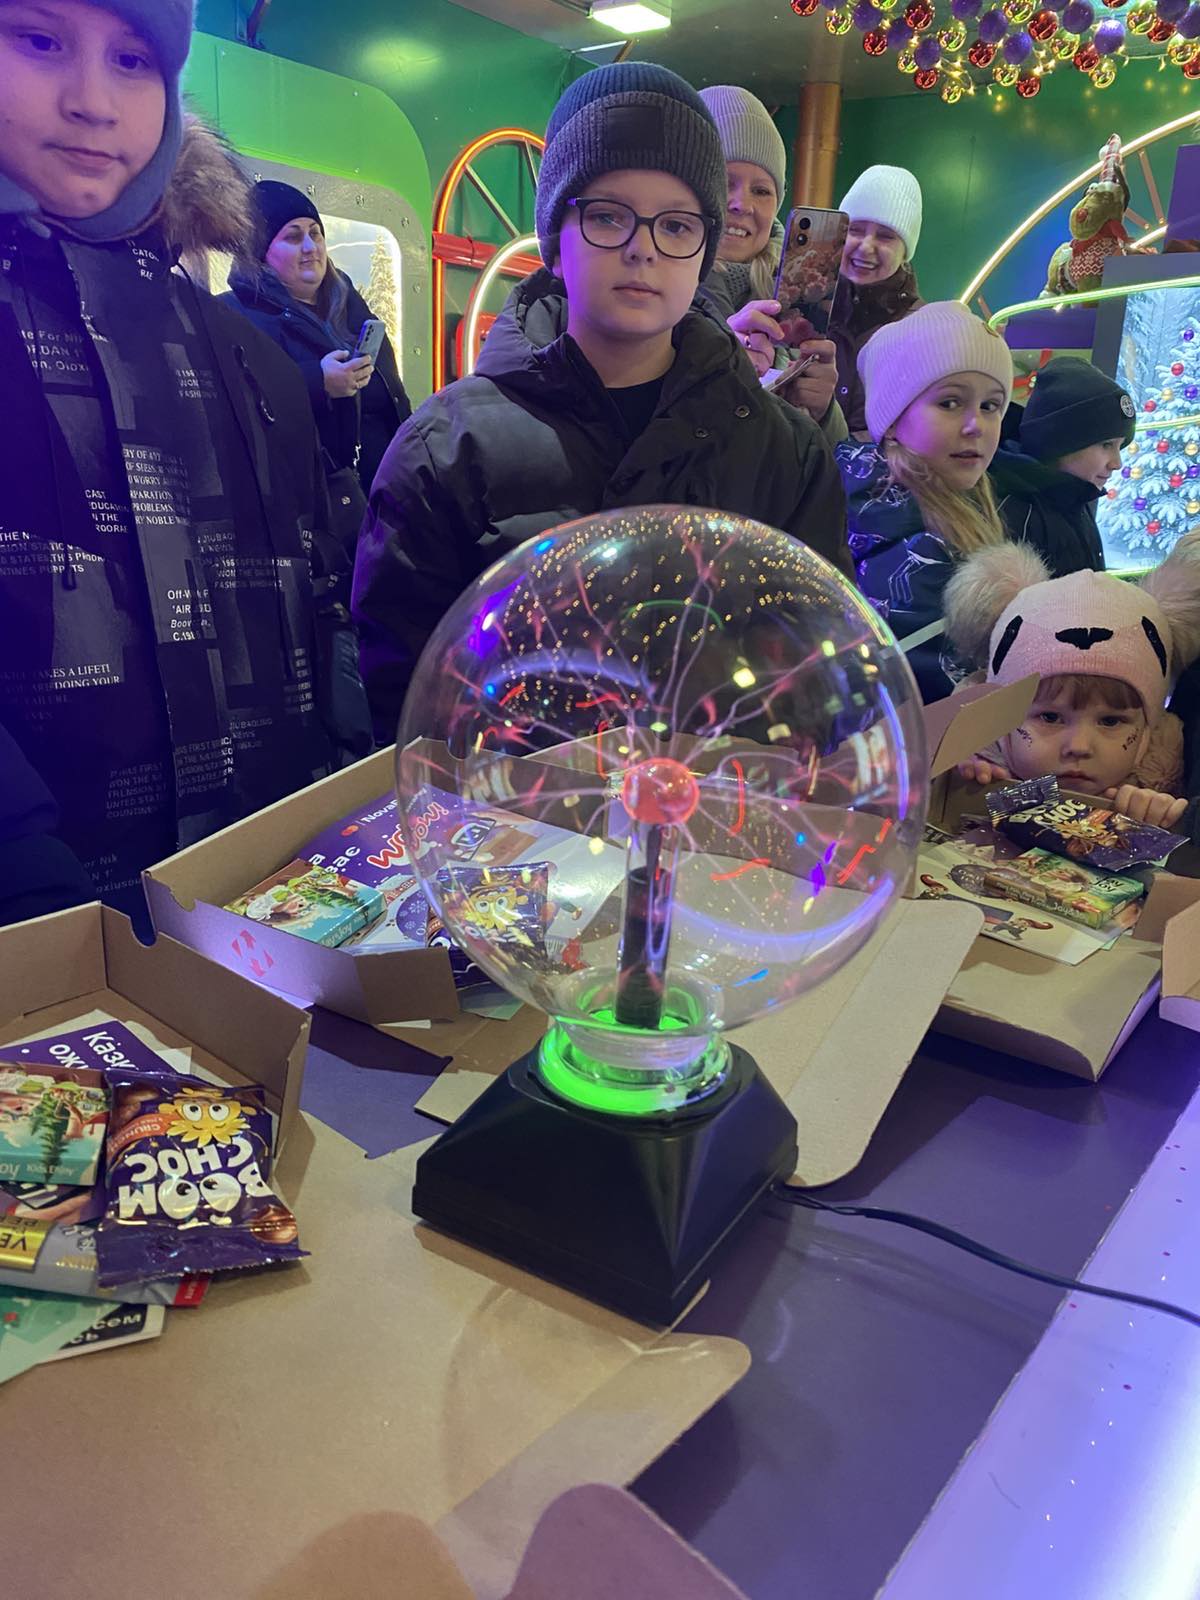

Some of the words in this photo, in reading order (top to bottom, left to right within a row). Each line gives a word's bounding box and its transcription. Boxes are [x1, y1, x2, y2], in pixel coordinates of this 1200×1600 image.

[99, 513, 119, 523] THE
[146, 515, 176, 526] NOBLE
[39, 563, 86, 575] PUPPTS
[54, 677, 91, 691] DOING
[1033, 798, 1087, 826] CHOC
[82, 1031, 139, 1071] Казк
[124, 1134, 254, 1184] CHOC
[118, 1161, 275, 1220] BOOM
